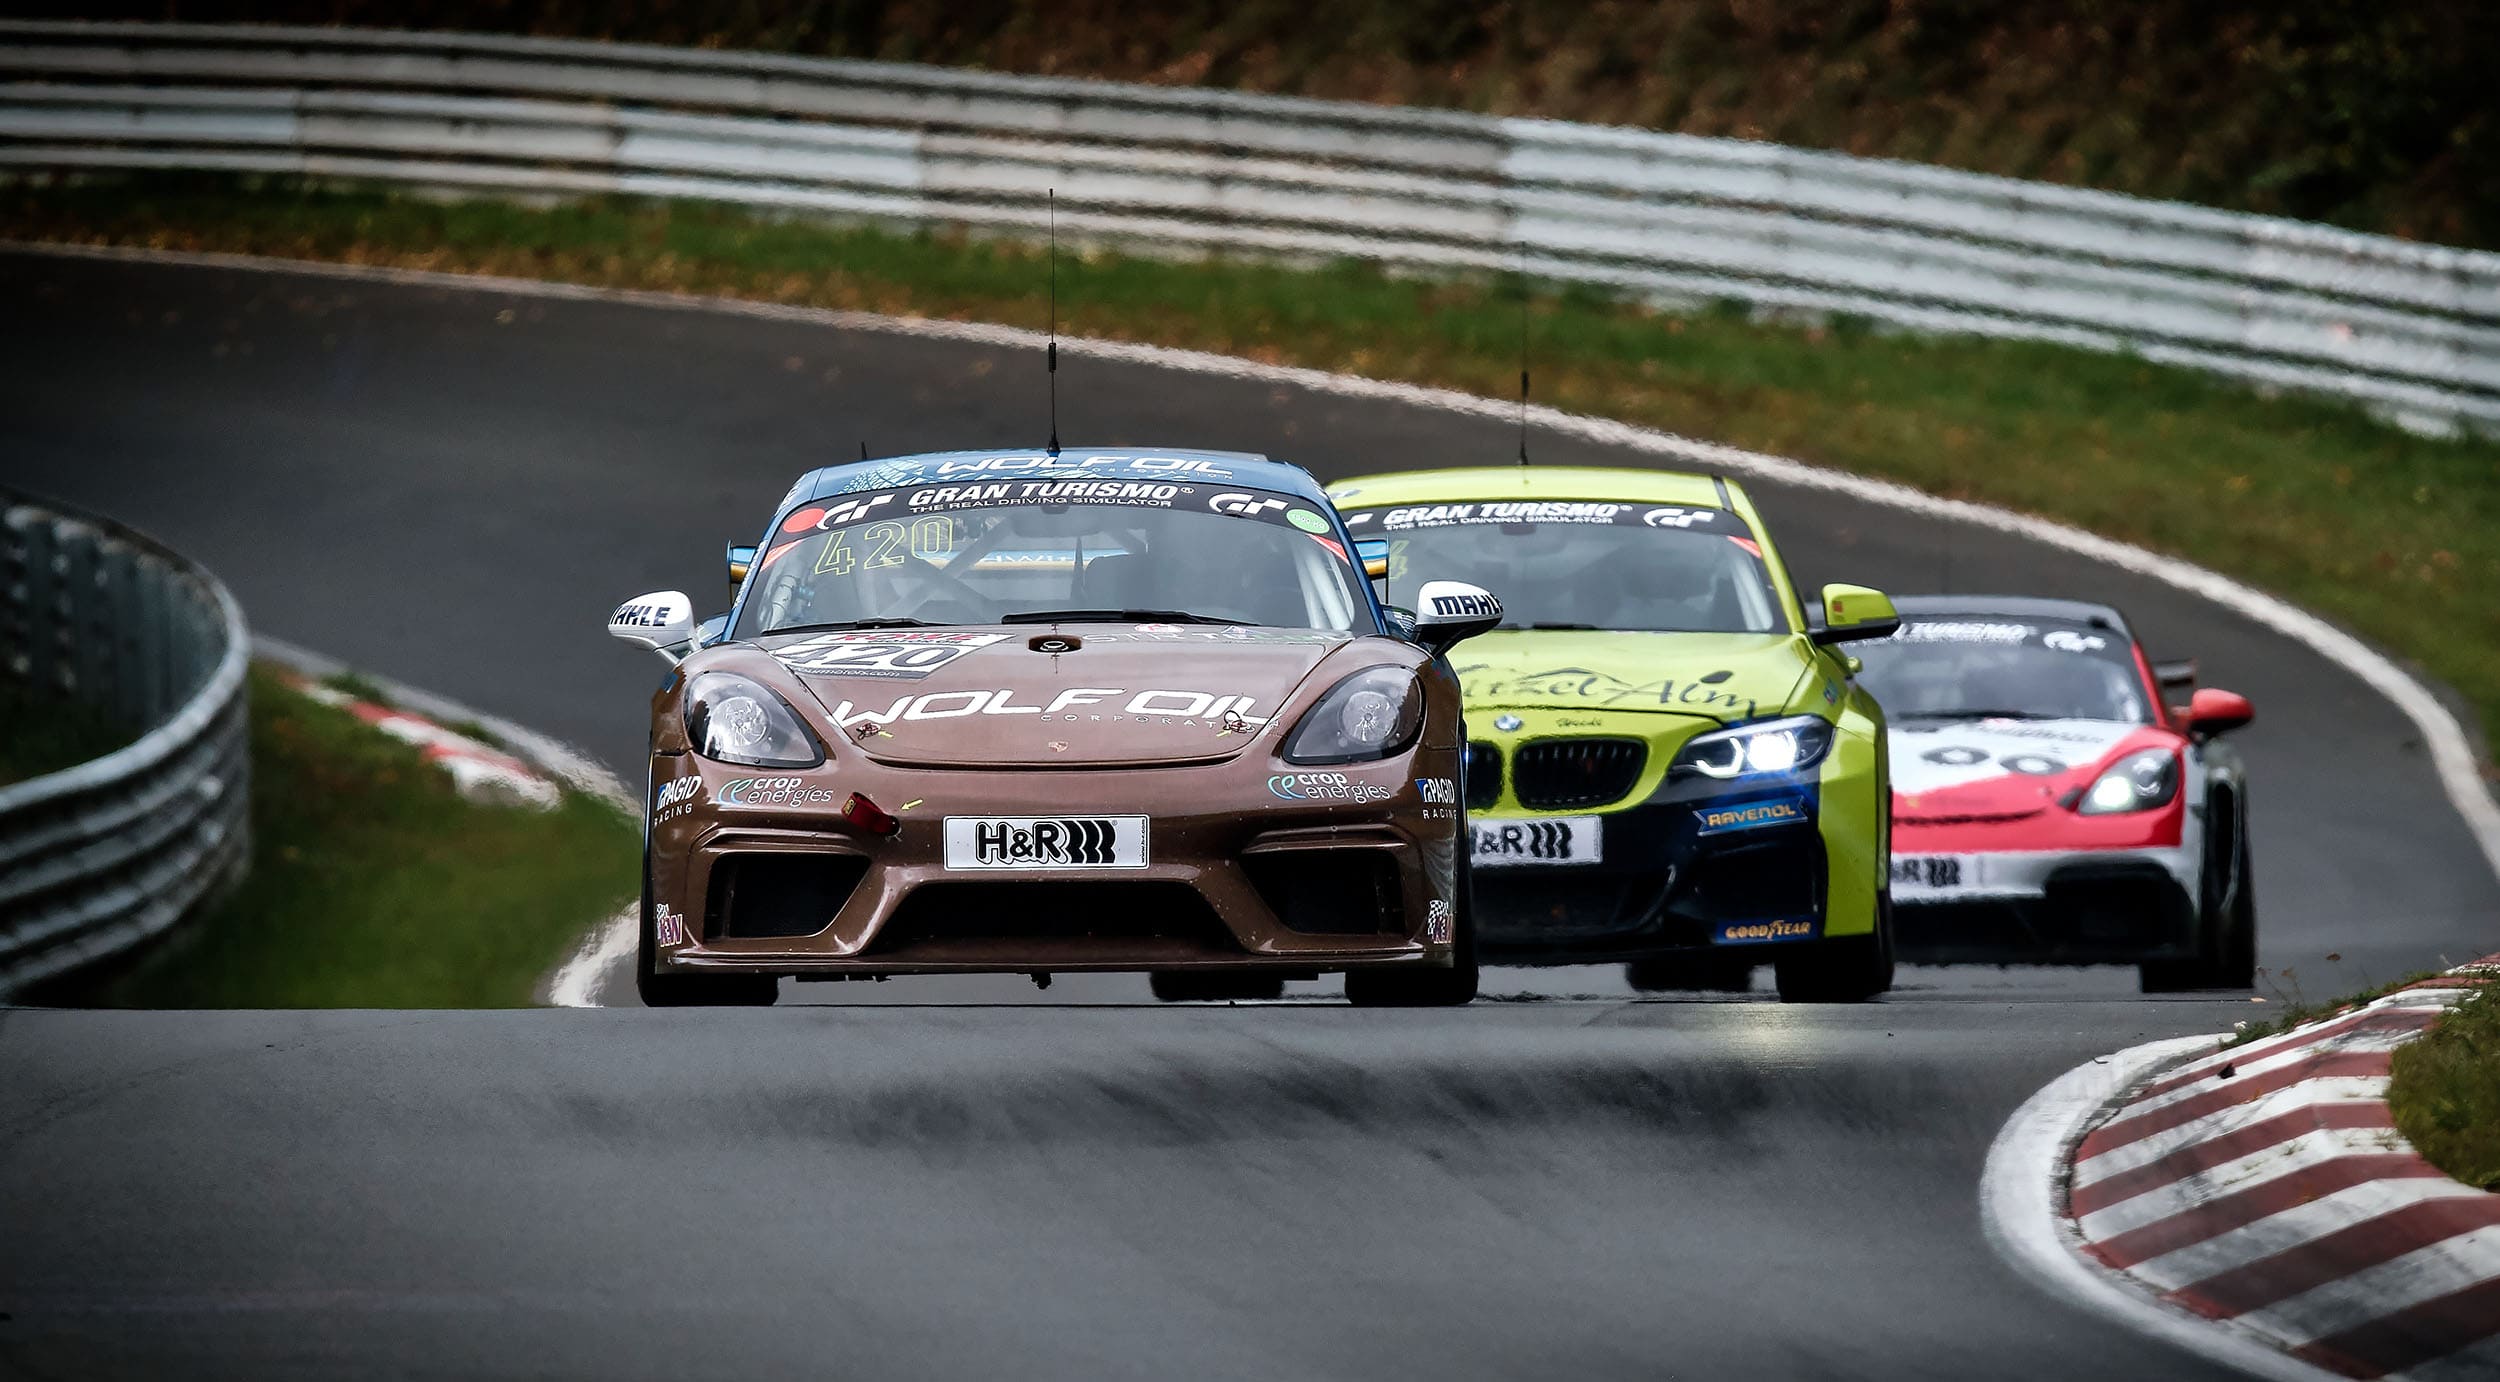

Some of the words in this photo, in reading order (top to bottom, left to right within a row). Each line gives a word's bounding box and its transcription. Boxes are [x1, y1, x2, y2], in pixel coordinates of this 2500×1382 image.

[936, 456, 1130, 474] WOLF
[1130, 457, 1233, 476] OIL
[908, 483, 1012, 506] GRAN
[910, 504, 944, 514] THE
[949, 501, 994, 509] REAL
[999, 497, 1068, 505] DRIVING
[1073, 498, 1172, 507] SIMULATOR
[1383, 504, 1474, 525] GRAN
[1418, 517, 1458, 527] REAL
[814, 515, 953, 576] 420
[774, 645, 961, 668] 420
[827, 688, 1126, 728] WOLF
[1124, 689, 1273, 727] OIL
[753, 777, 802, 793] crop
[1298, 773, 1348, 788] crop
[1725, 919, 1811, 941] GOODYEAR
